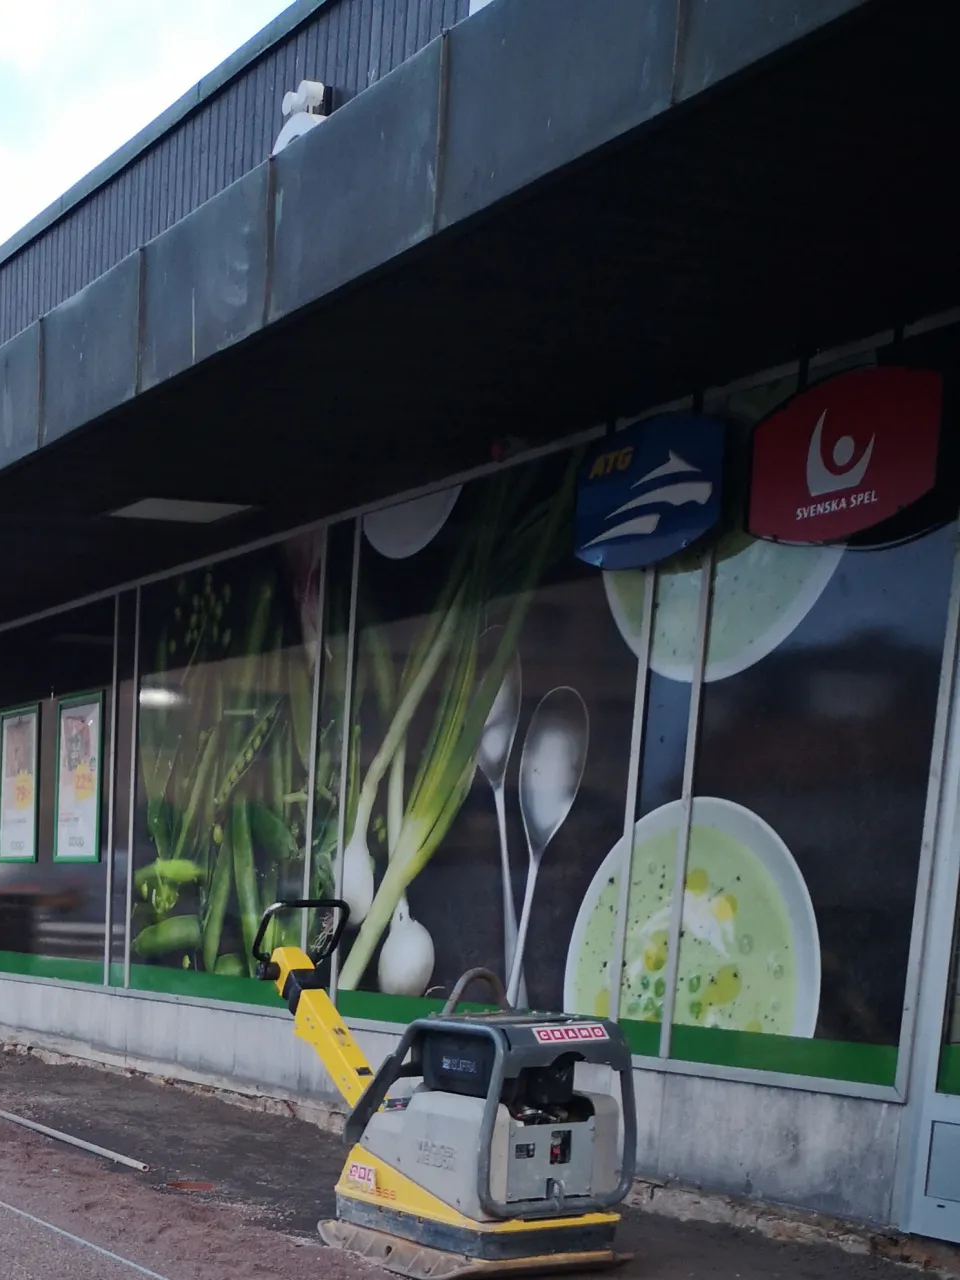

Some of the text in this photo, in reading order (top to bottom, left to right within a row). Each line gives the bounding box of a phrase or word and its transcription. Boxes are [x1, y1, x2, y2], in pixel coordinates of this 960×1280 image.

[589, 446, 634, 480] ATG
[795, 490, 878, 520] SVENSKA SPEL
[538, 1026, 603, 1040] CRAMO
